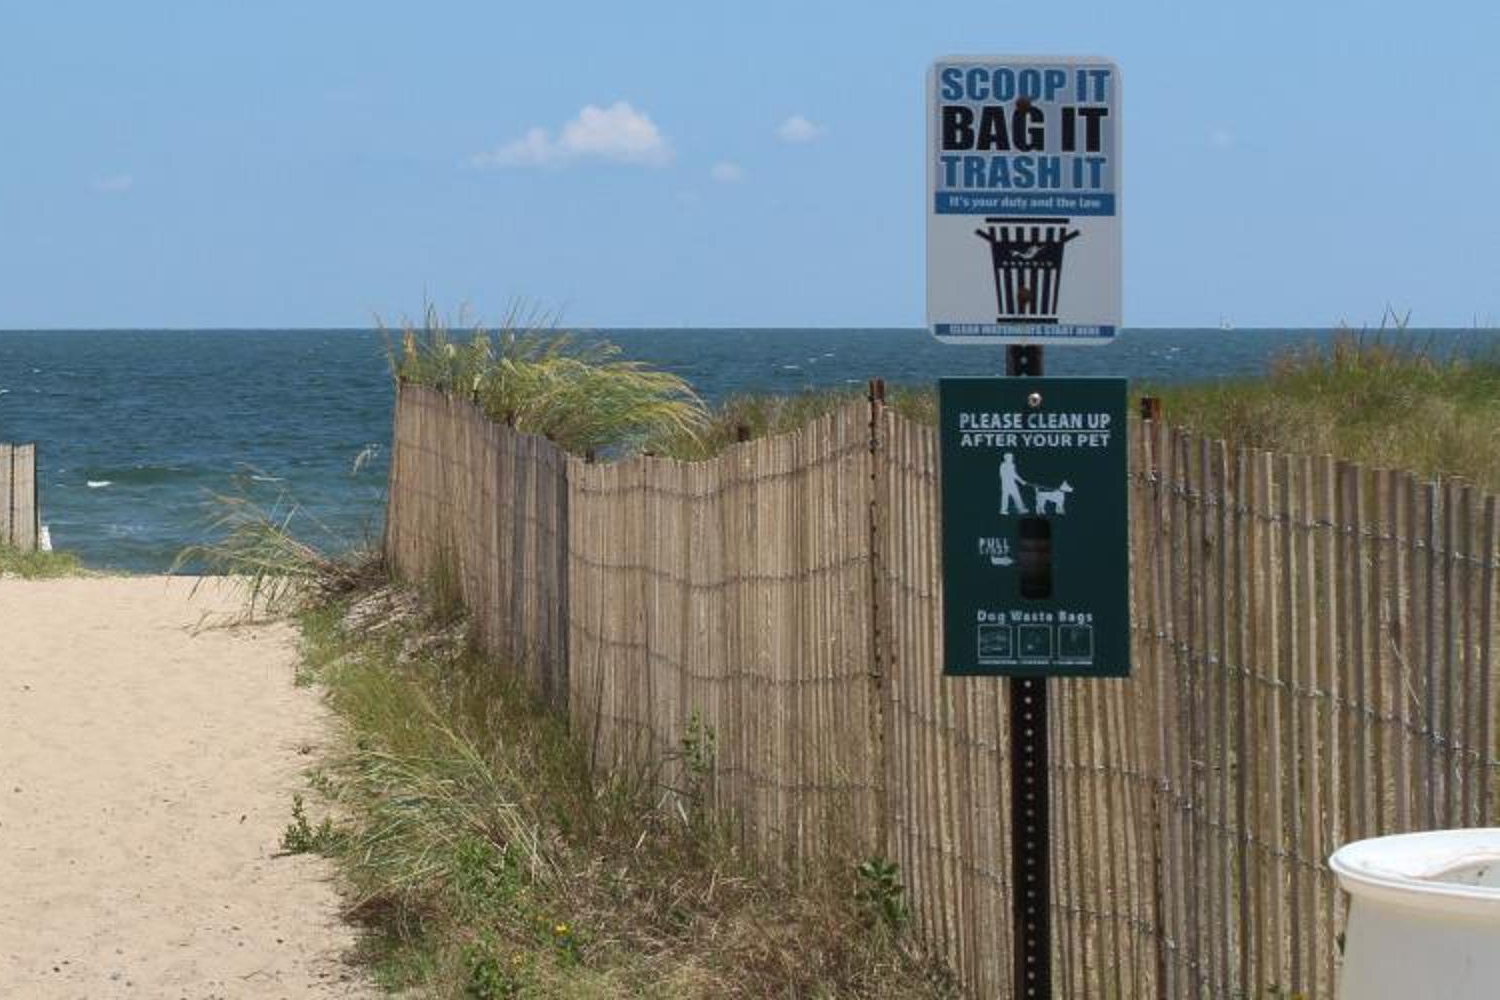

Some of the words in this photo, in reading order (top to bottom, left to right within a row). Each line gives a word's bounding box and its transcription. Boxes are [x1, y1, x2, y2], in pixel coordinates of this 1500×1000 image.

[942, 68, 1066, 101] SCOOP
[1077, 69, 1110, 101] IT
[942, 106, 1044, 152] BAG
[1062, 107, 1108, 152] IT
[940, 156, 1061, 188] TRASH
[1073, 157, 1106, 188] IT
[949, 196, 969, 208] It's
[971, 198, 998, 210] your
[1001, 196, 1027, 210] duty
[1030, 196, 1053, 208] and
[1056, 196, 1076, 208] the
[1080, 196, 1100, 208] law
[960, 413, 1022, 429] PLEASE
[1028, 413, 1083, 429] CLEAN
[1088, 413, 1111, 429] UP
[961, 434, 1017, 447] AFTER
[1022, 434, 1072, 447] YOUR
[1077, 434, 1110, 447] PET
[977, 610, 1005, 624] Dog
[1010, 610, 1053, 622] Waste
[1059, 611, 1093, 625] Bags
